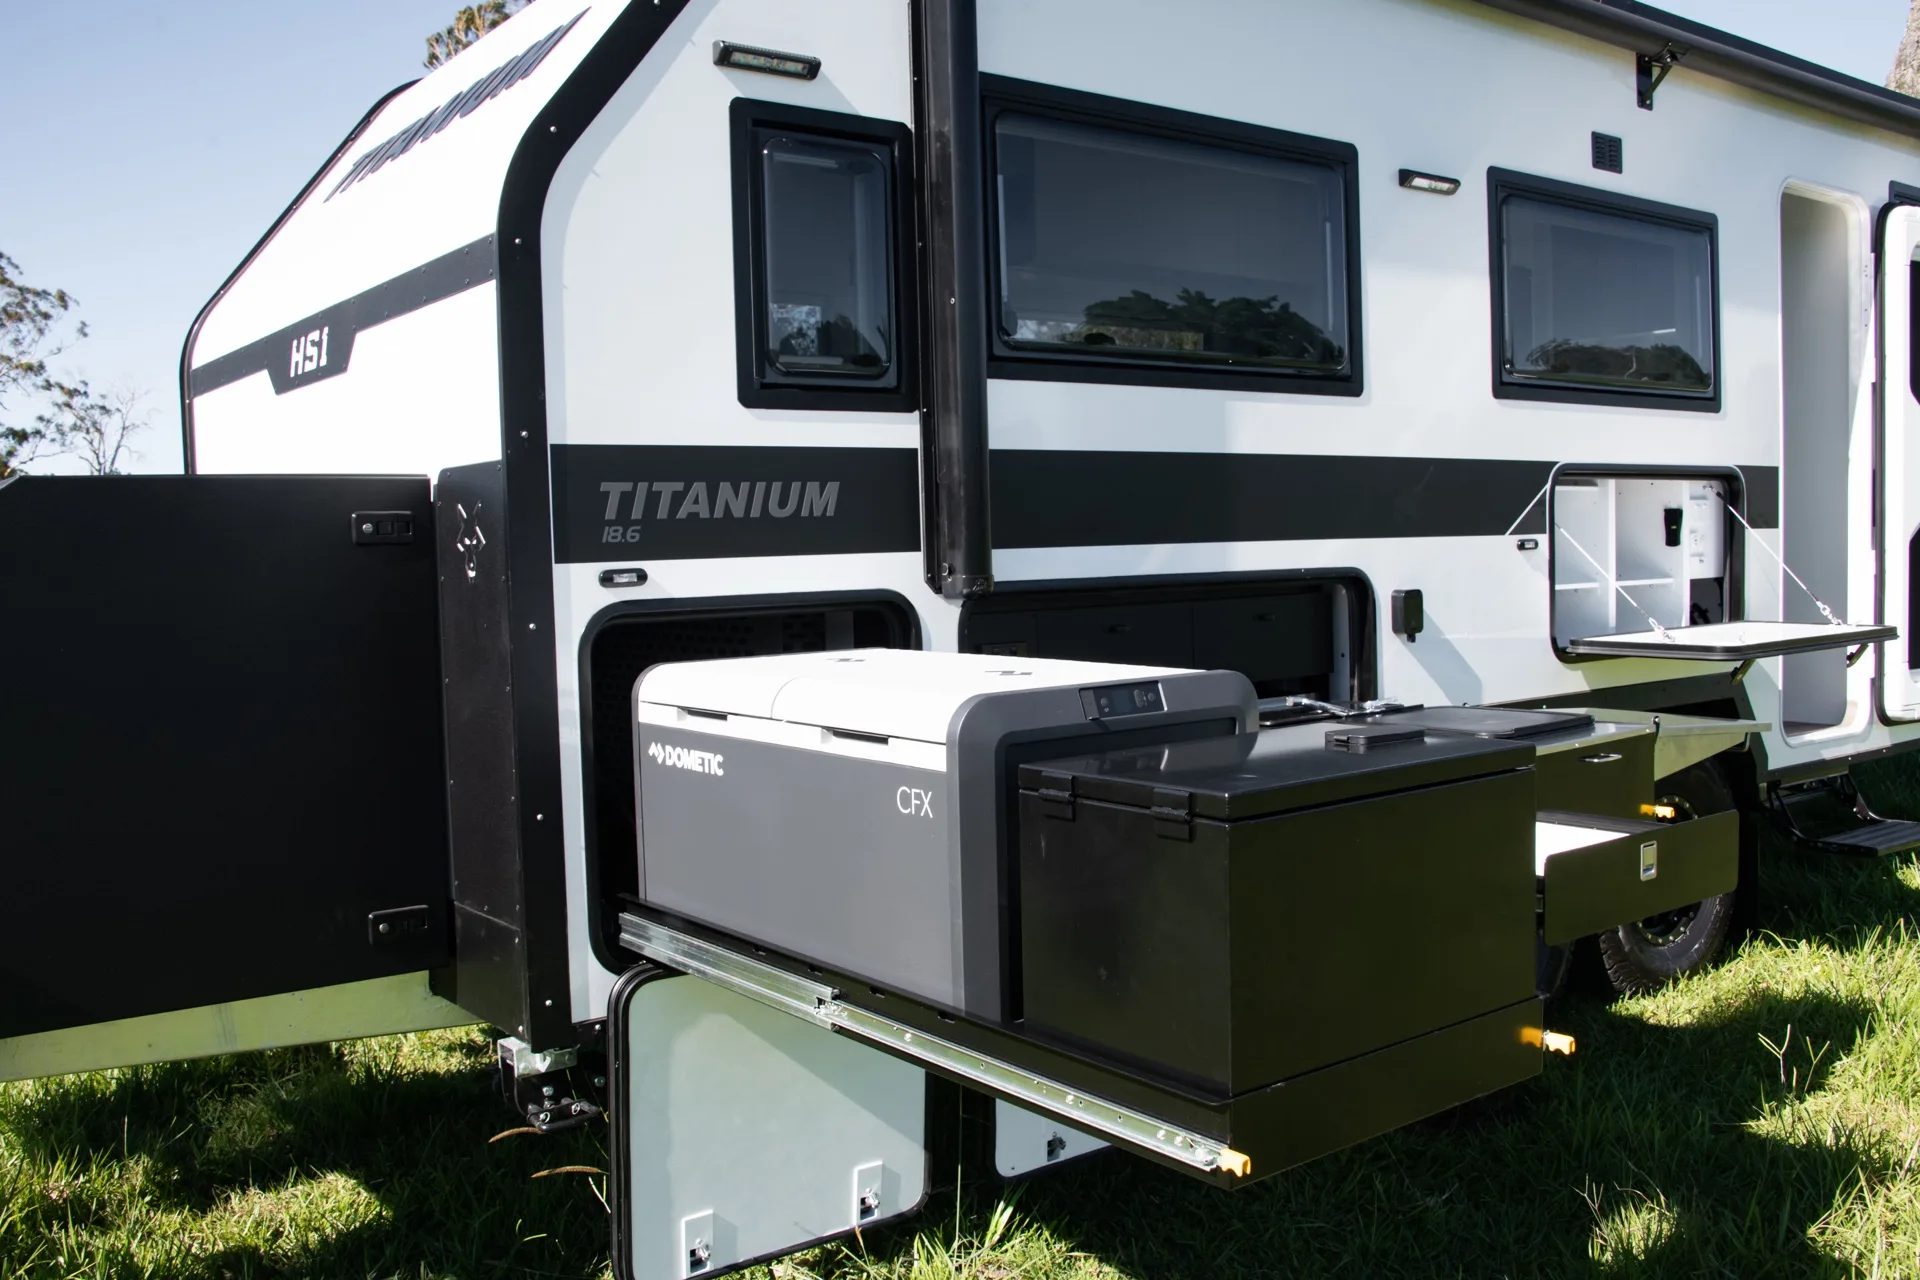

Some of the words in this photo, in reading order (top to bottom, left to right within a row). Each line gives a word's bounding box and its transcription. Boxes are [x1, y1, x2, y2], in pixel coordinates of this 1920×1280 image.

[600, 481, 840, 520] TITANIUM
[602, 526, 641, 543] 18.6
[665, 744, 724, 776] DOMETIC
[896, 786, 933, 818] CFX
